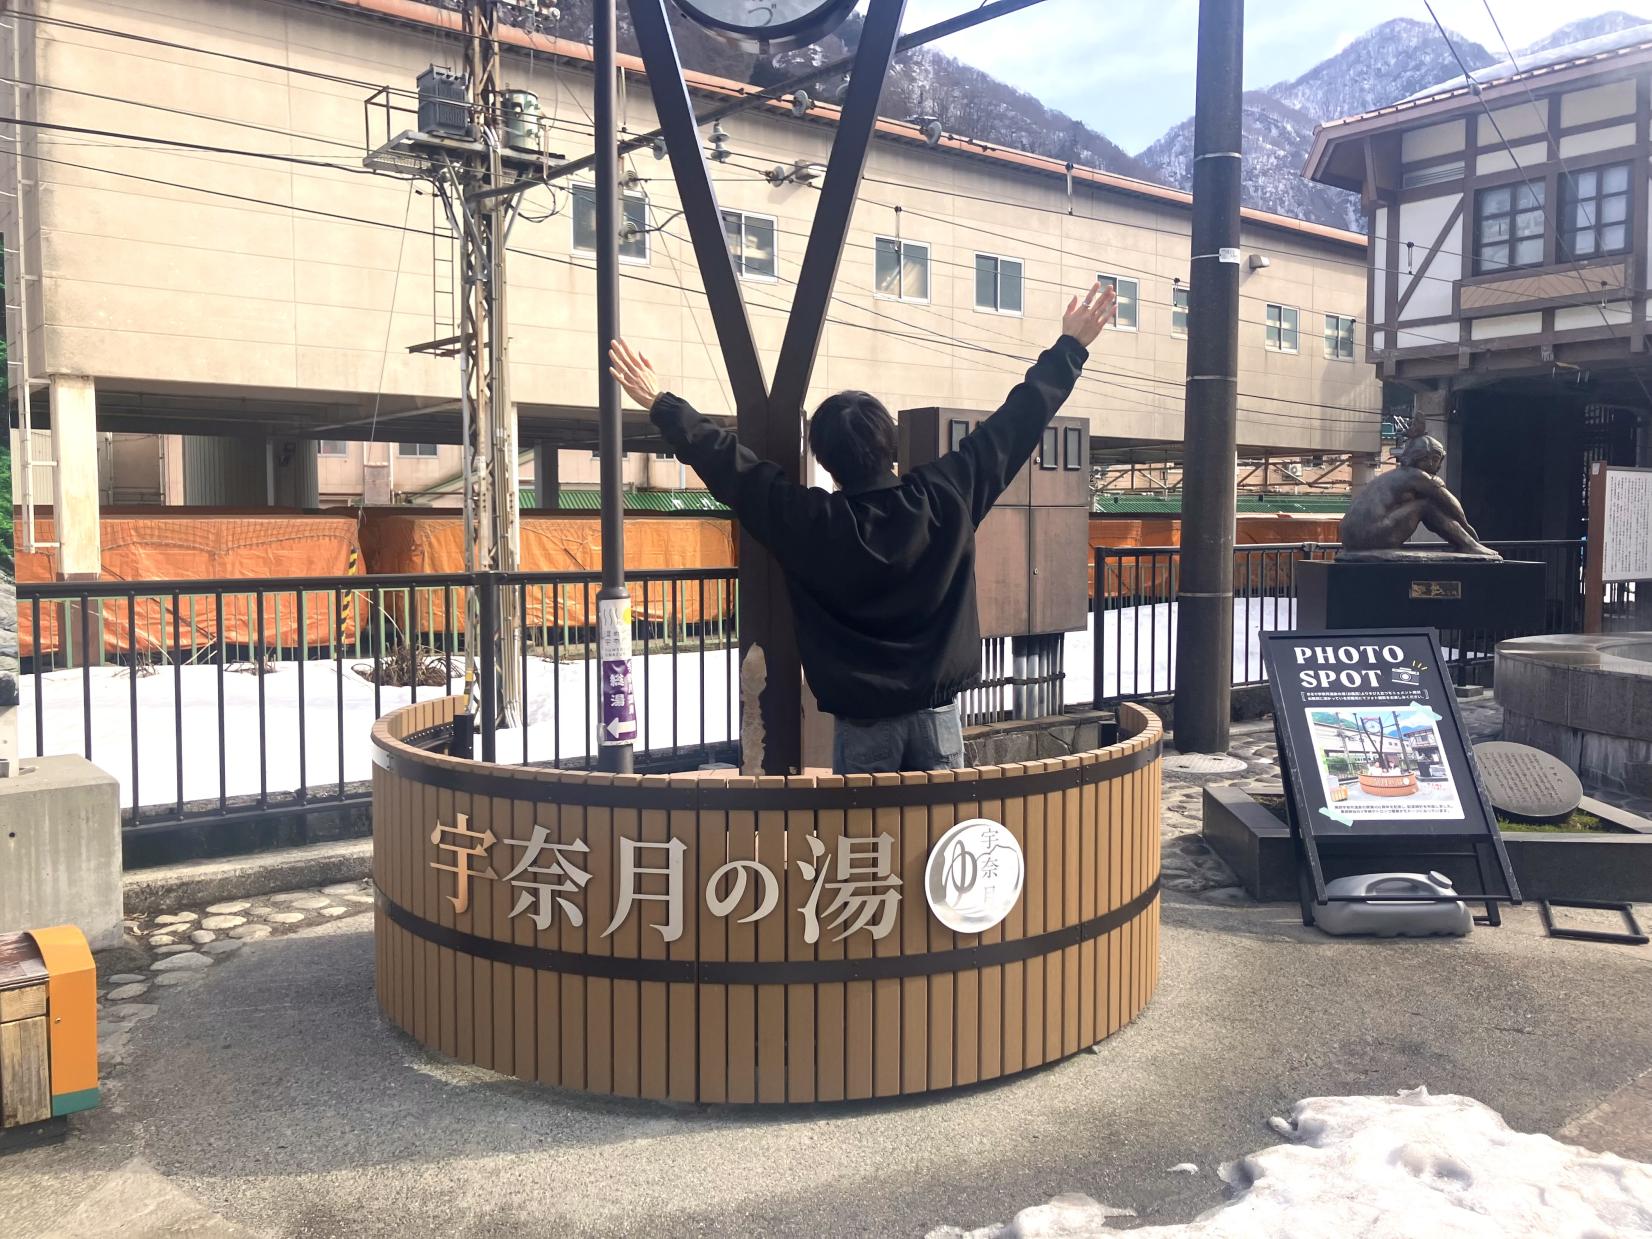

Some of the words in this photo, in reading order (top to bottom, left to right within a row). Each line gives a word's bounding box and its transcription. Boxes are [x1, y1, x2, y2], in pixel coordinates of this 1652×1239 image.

[1293, 645, 1404, 664] PHOTO
[1300, 669, 1382, 688] SPOT
[430, 812, 903, 945] 宇奈月の湯
[980, 827, 1000, 904] 宇奈月
